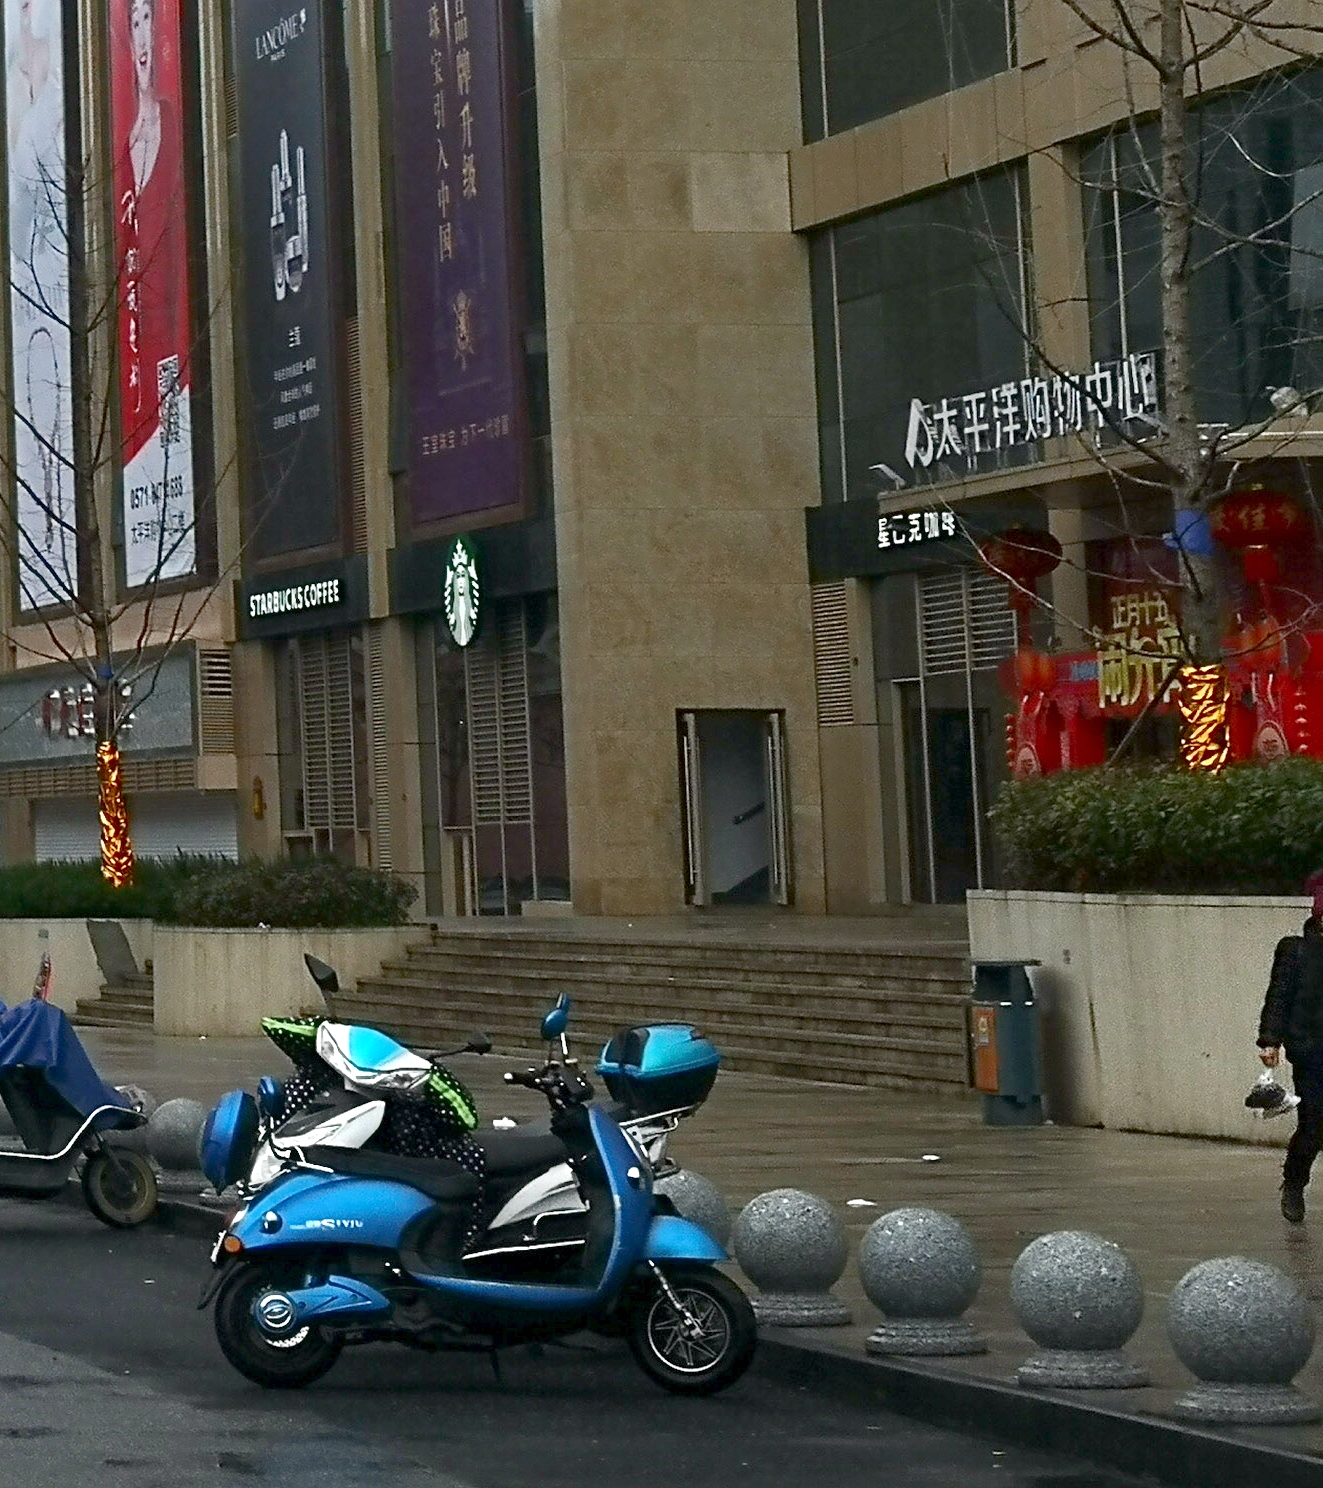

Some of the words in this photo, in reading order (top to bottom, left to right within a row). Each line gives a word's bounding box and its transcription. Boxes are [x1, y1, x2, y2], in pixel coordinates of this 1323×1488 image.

[935, 354, 1153, 455] 太平洋购物中心
[250, 589, 302, 617] STARBUCKS
[304, 579, 340, 608] COFFEE
[1111, 591, 1170, 629] 正月十五
